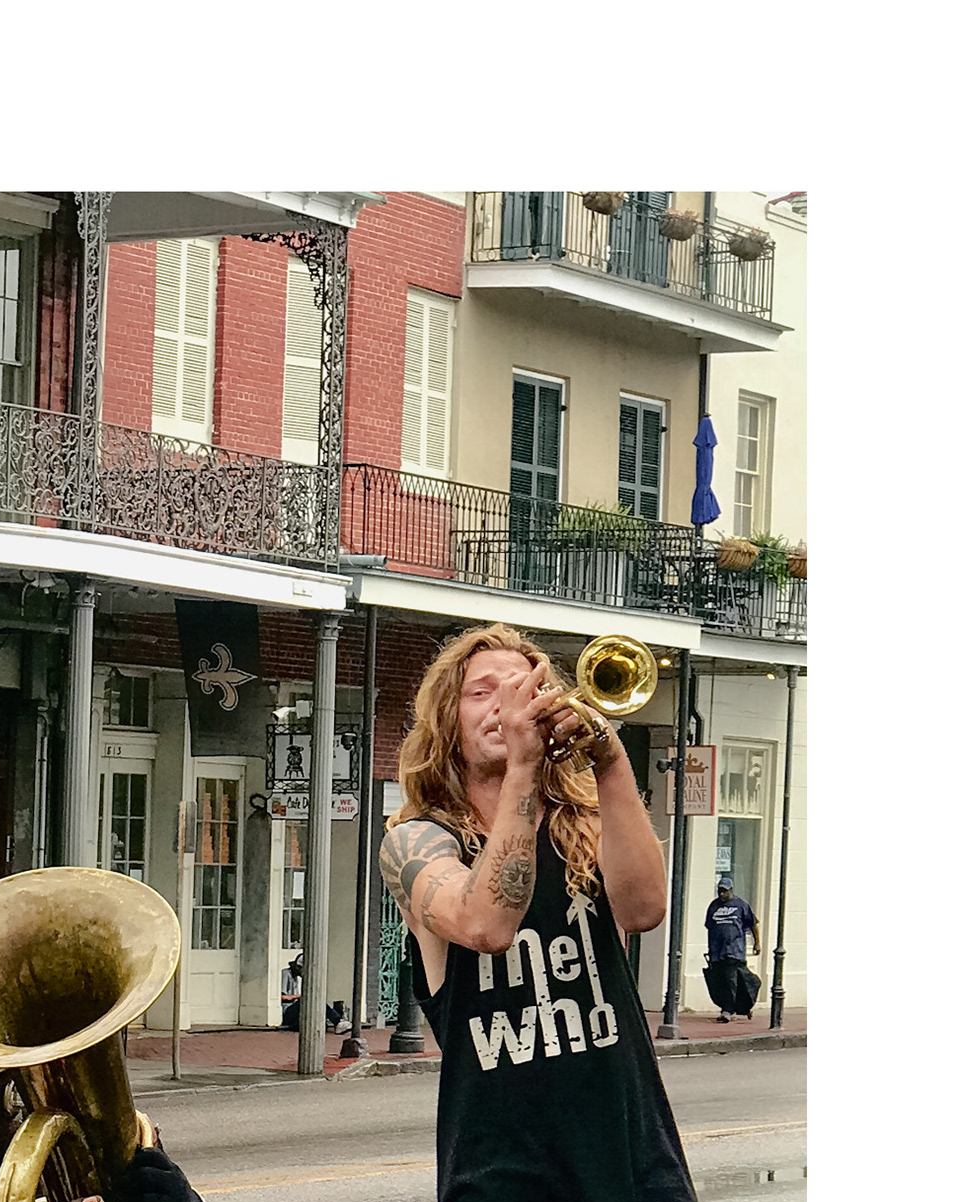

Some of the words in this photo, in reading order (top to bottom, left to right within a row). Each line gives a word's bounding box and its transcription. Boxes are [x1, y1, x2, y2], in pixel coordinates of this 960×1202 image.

[673, 789, 707, 802] ALINE
[478, 928, 582, 992] me
[468, 998, 620, 1072] who
